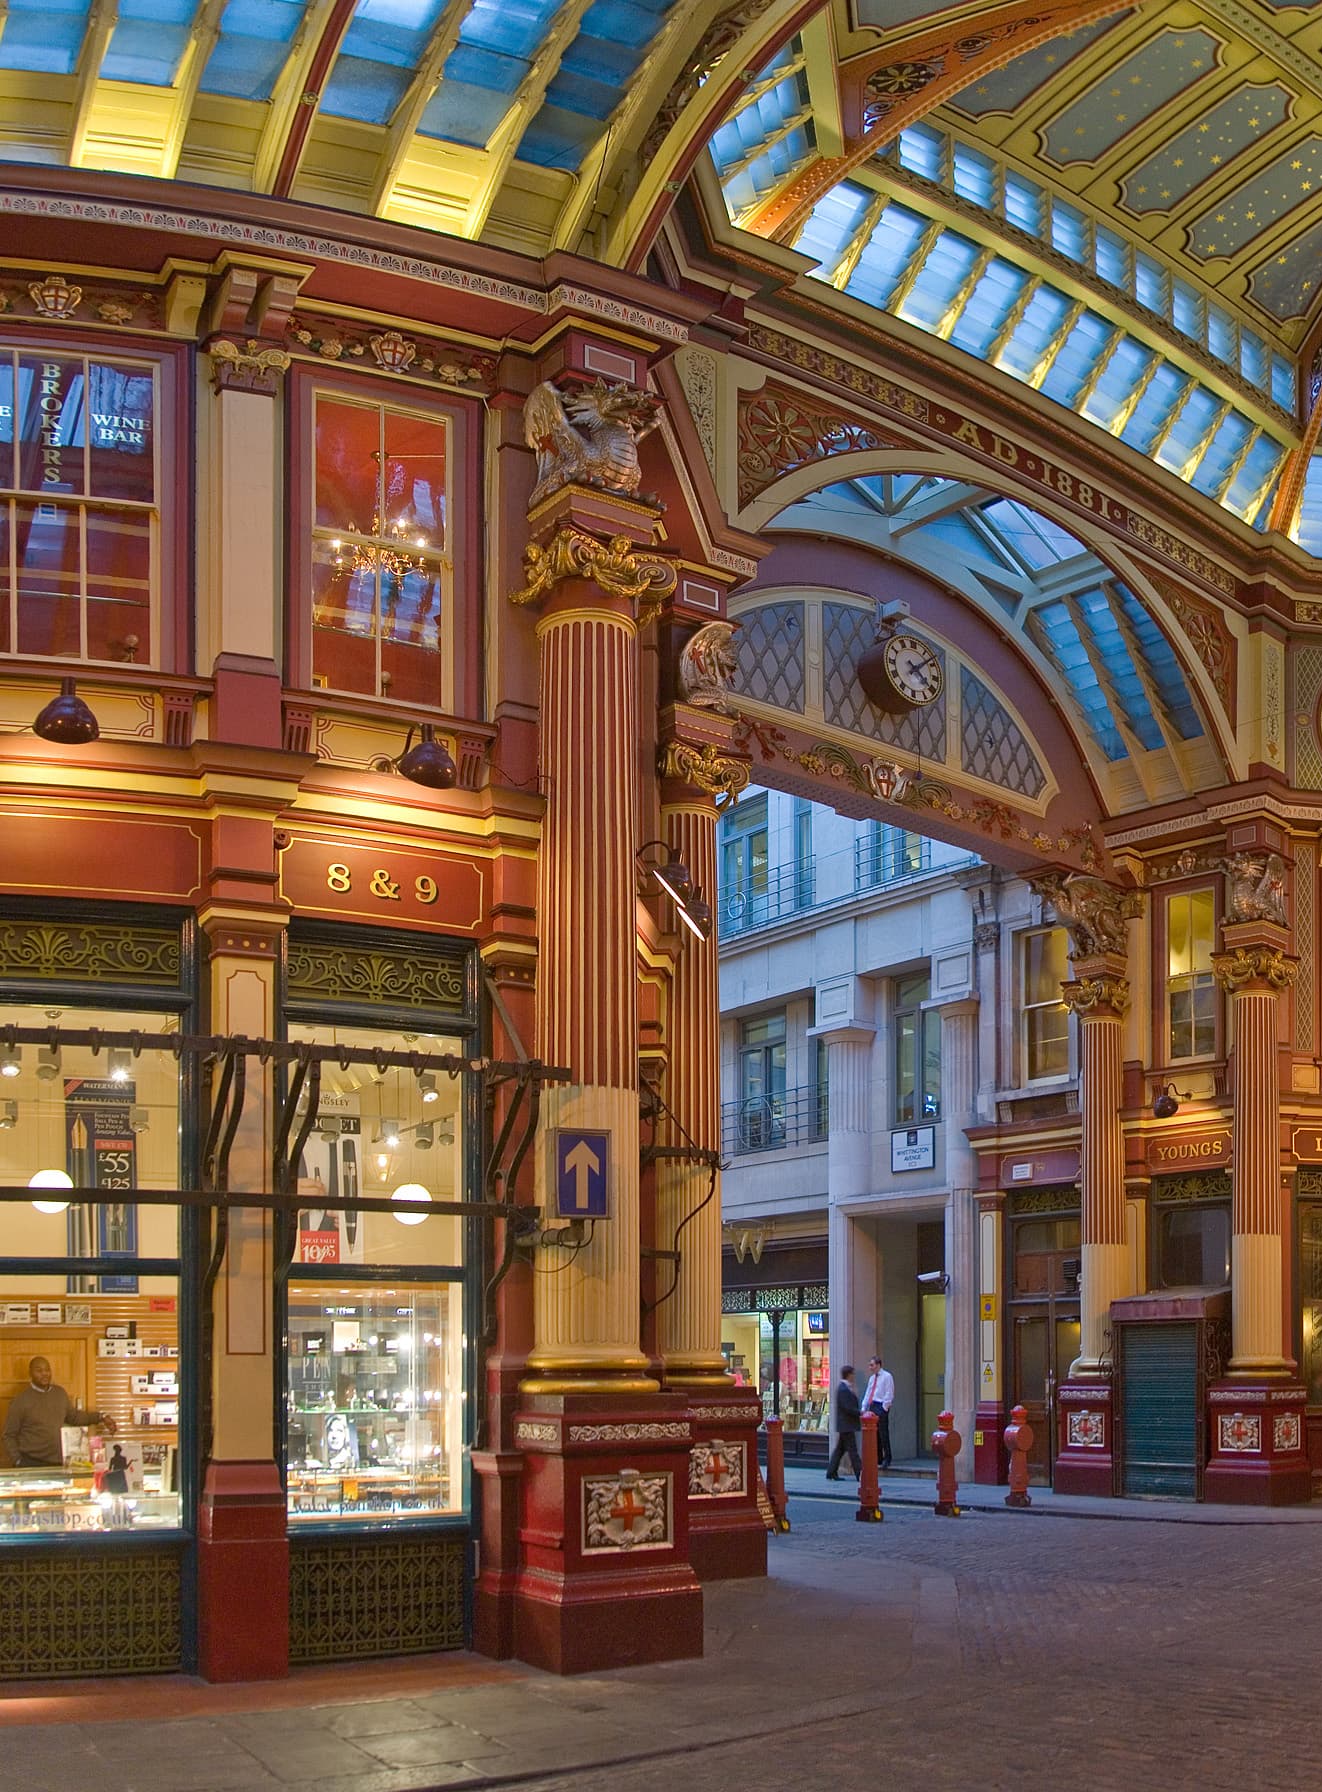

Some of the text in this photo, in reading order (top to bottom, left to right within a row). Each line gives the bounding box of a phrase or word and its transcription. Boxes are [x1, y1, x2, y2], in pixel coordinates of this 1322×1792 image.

[40, 363, 63, 483] BROKERS
[91, 413, 151, 431] WINE
[100, 428, 143, 444] BAR
[1040, 460, 1111, 520] 1881
[327, 863, 438, 903] 8 & 9
[319, 1098, 350, 1107] NGSLEY
[1158, 1140, 1222, 1160] YOUNGS
[99, 1152, 129, 1173] £55
